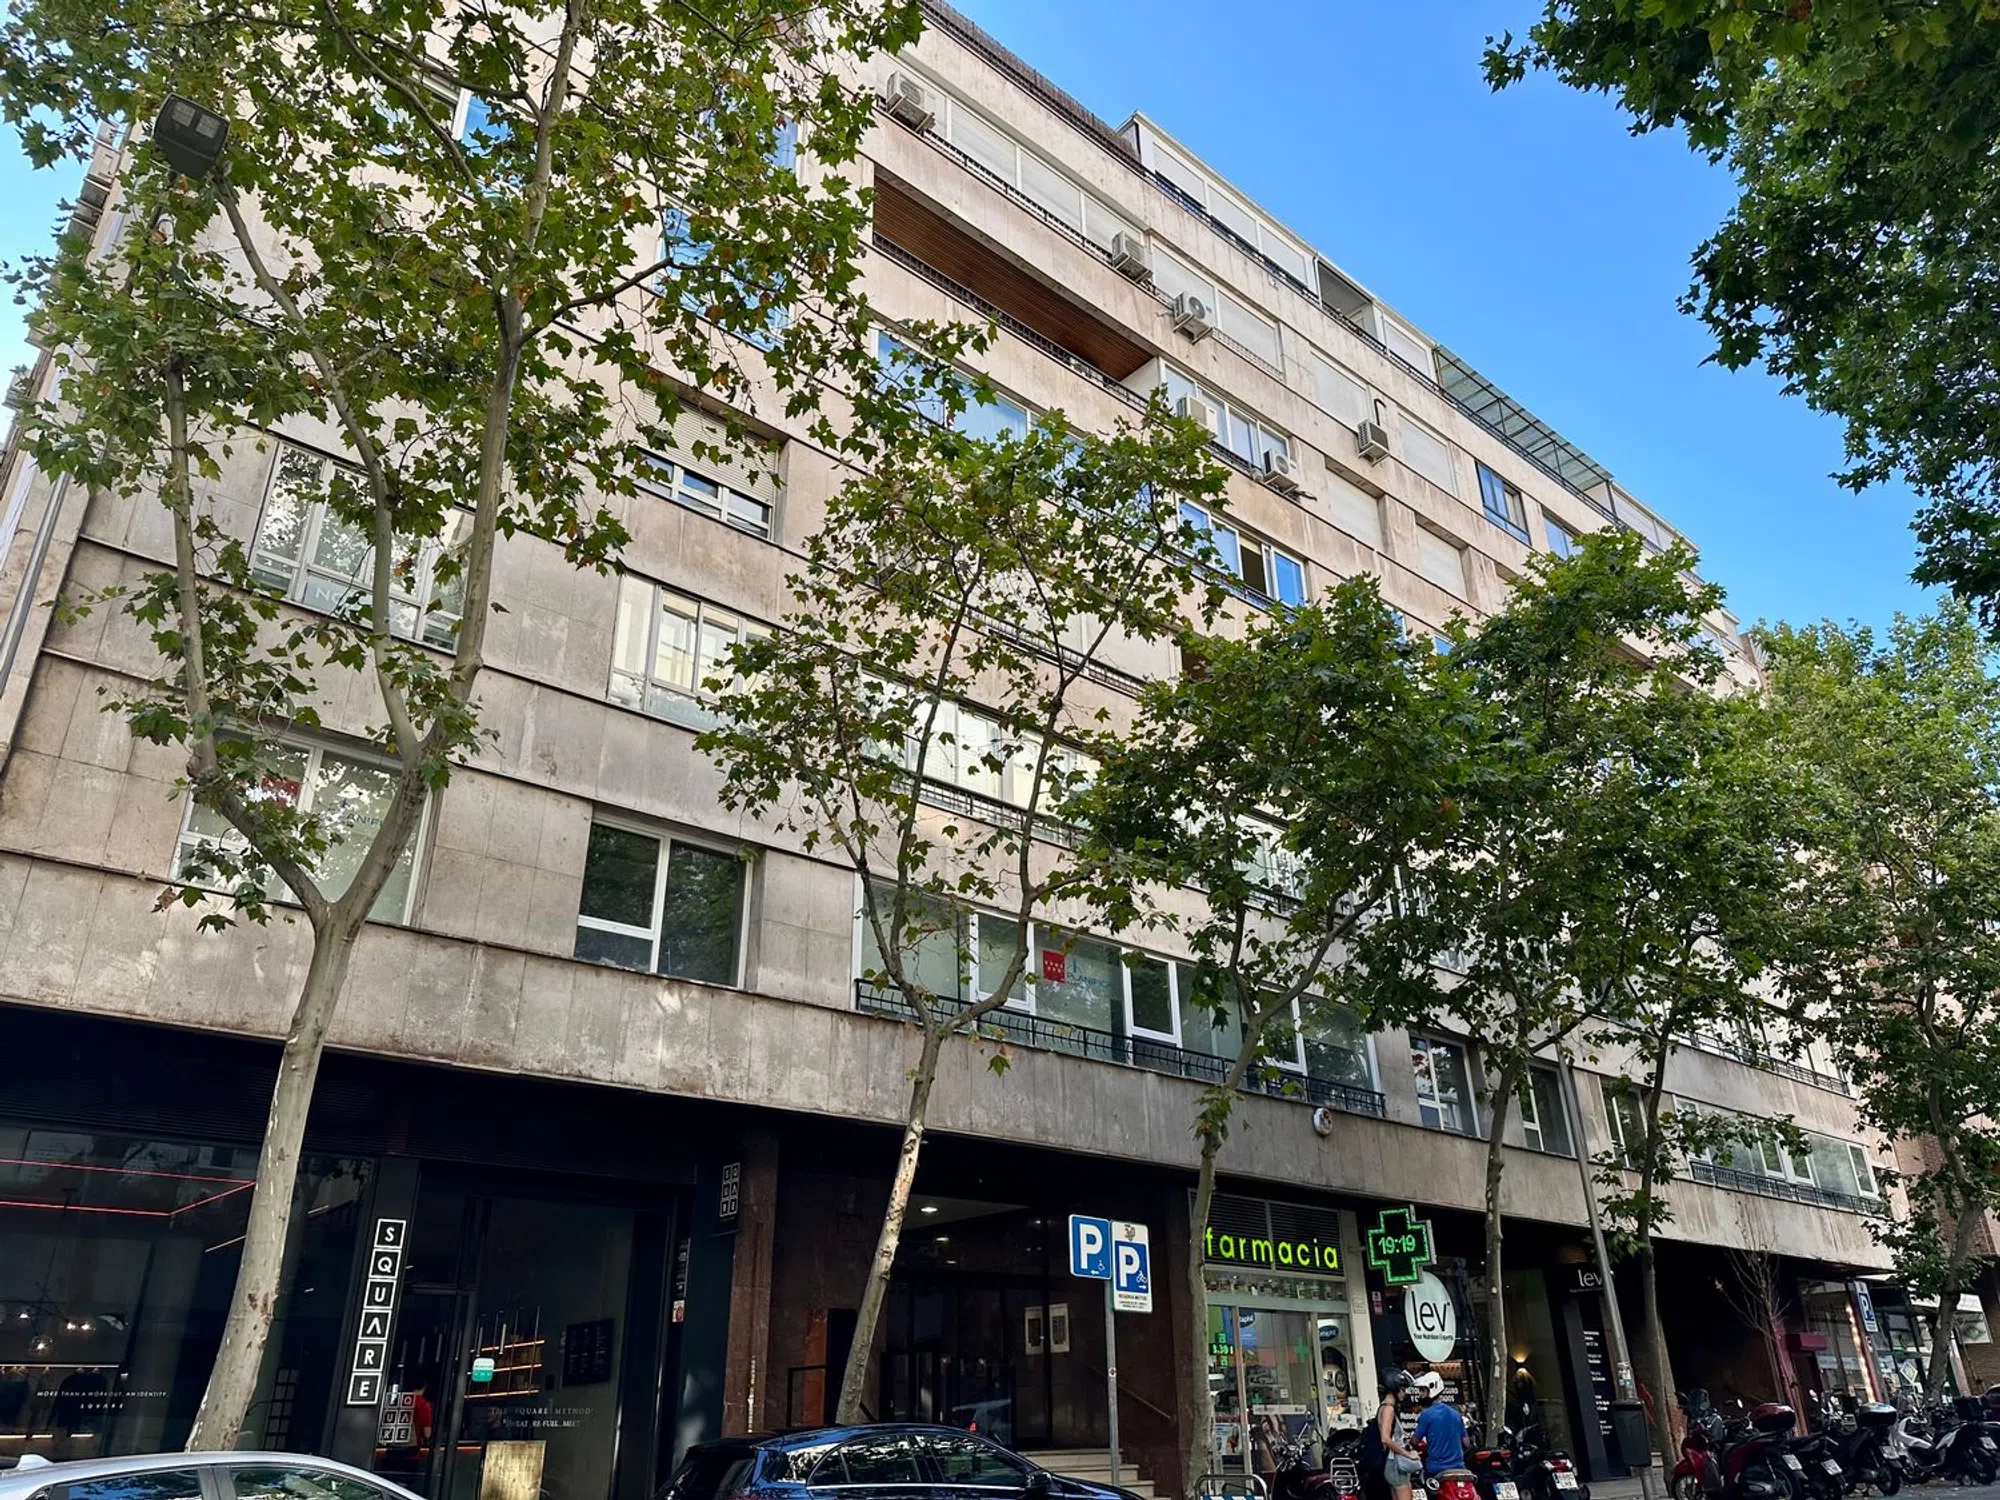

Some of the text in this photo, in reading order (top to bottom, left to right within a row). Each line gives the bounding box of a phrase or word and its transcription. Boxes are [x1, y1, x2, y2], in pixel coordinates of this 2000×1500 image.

[1079, 1223, 1103, 1270] P
[1205, 1226, 1339, 1269] farmacia
[1378, 1234, 1416, 1255] 19:19
[1118, 1245, 1140, 1288] P
[1411, 1290, 1448, 1333] lev
